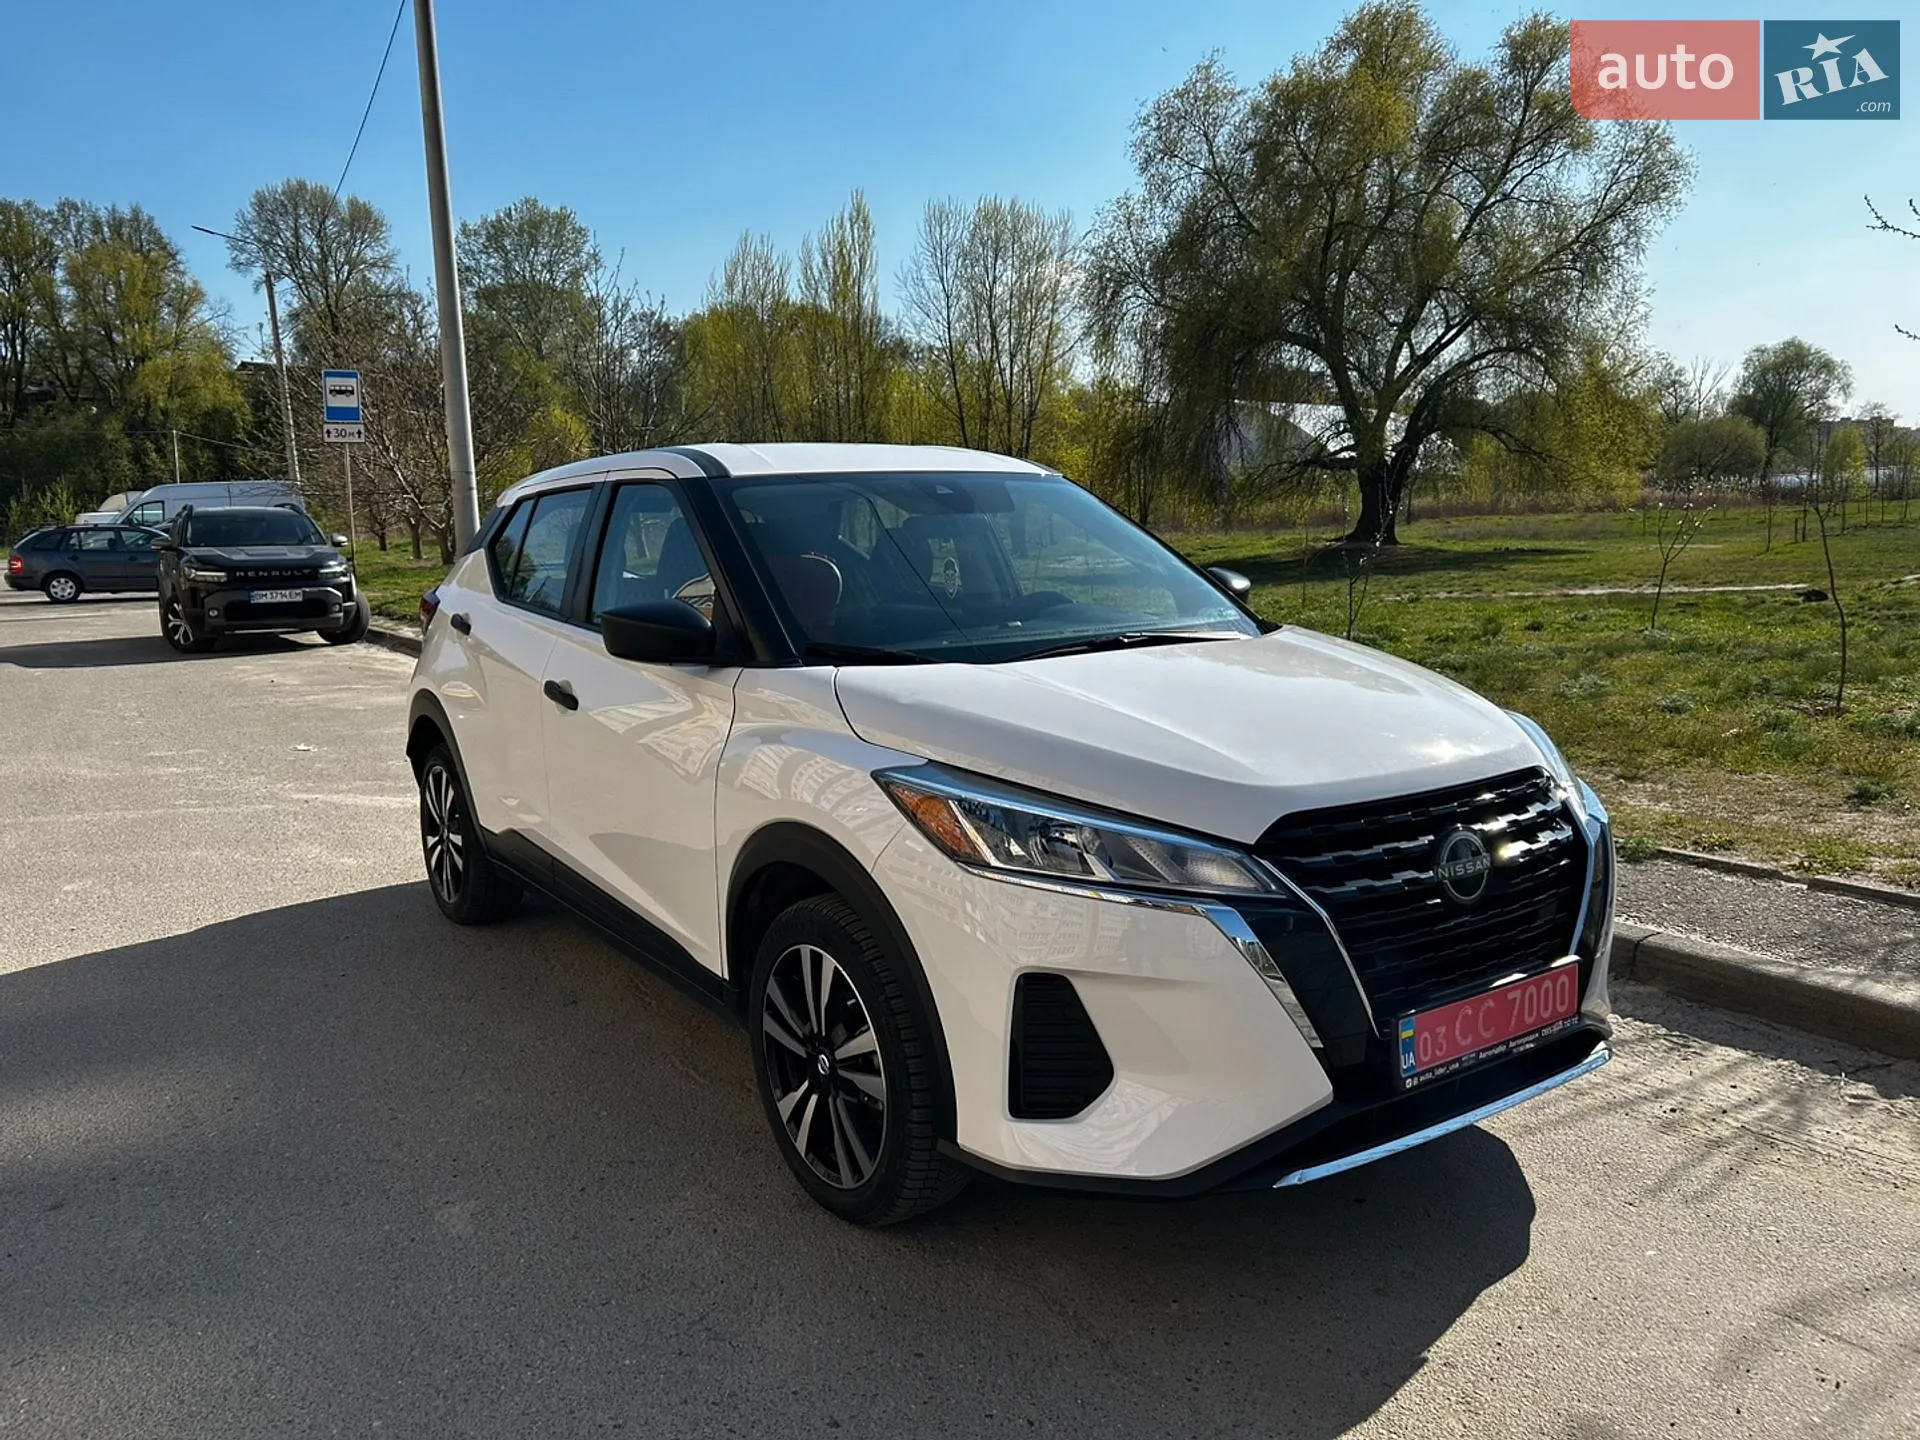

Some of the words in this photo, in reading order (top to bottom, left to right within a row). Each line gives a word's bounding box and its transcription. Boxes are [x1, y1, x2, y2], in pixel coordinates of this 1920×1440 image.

[332, 428, 347, 438] 30
[235, 569, 312, 577] RENAULT
[1438, 858, 1490, 878] NISSAN
[1420, 1025, 1447, 1061] 03
[1455, 1000, 1496, 1046] CC
[1507, 974, 1570, 1032] 7000
[1401, 1051, 1416, 1069] UA
